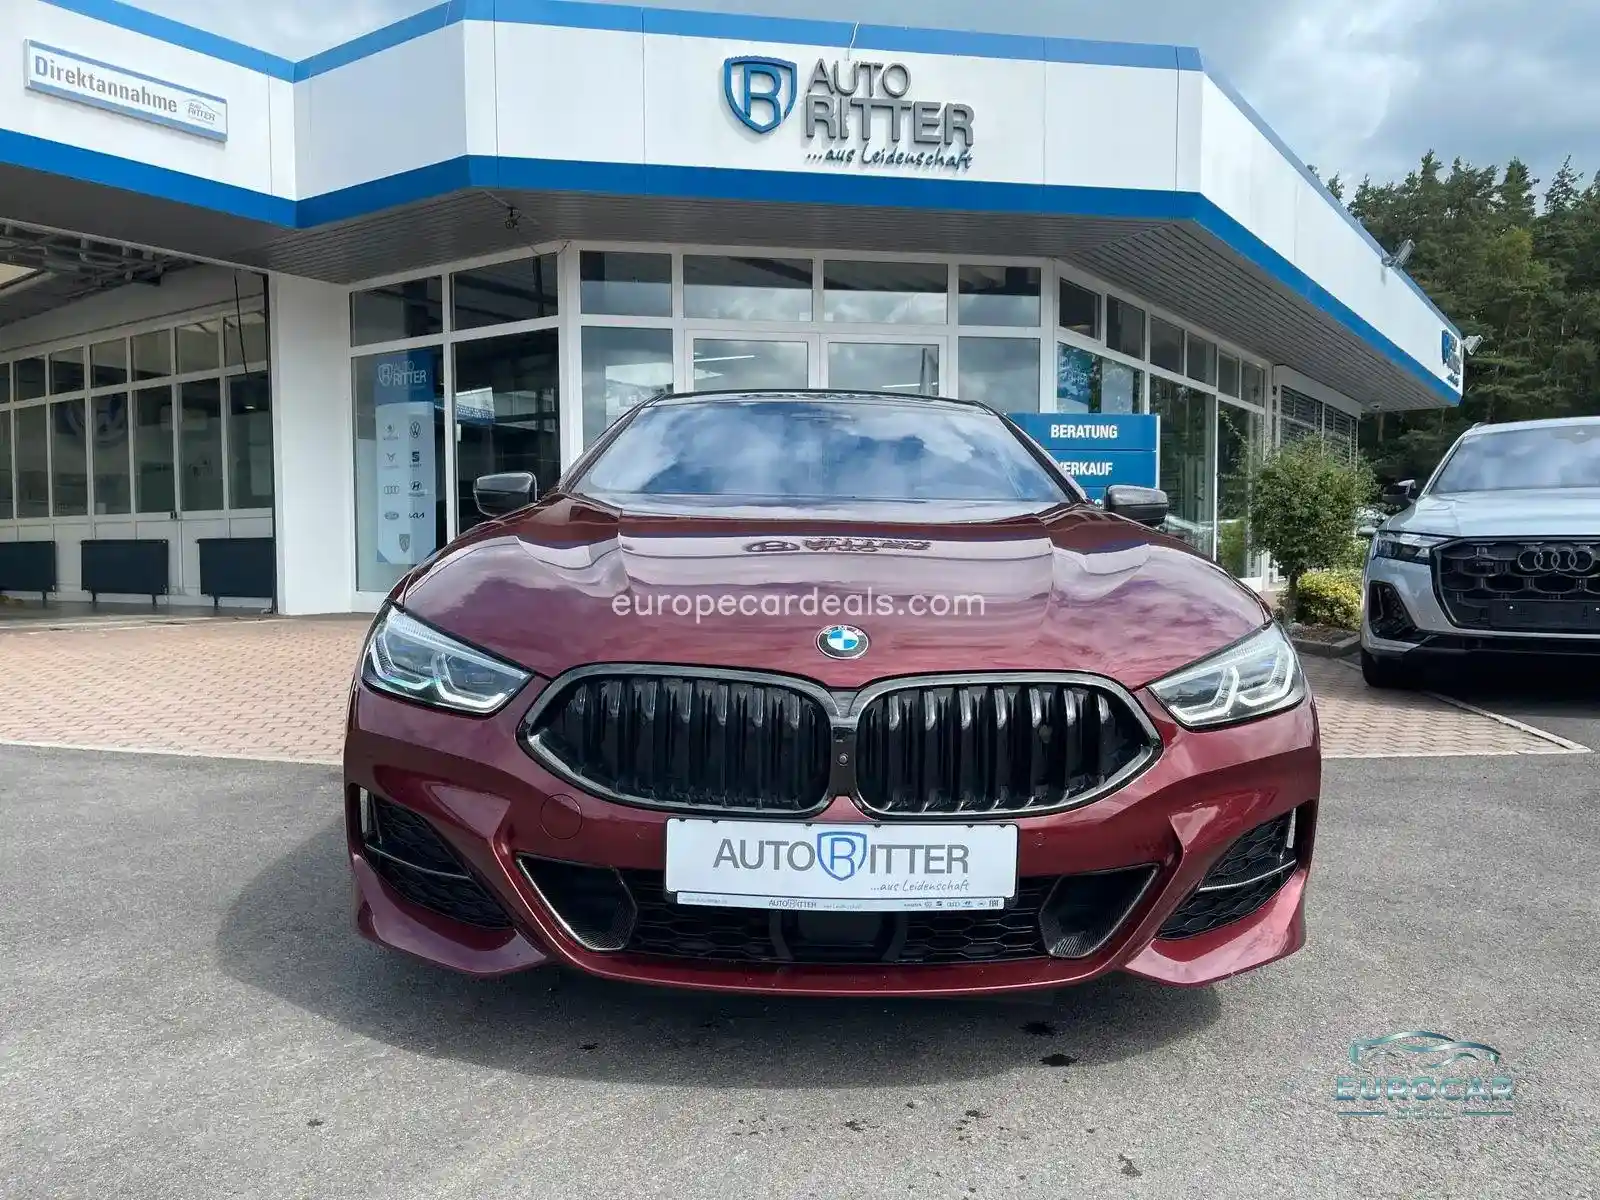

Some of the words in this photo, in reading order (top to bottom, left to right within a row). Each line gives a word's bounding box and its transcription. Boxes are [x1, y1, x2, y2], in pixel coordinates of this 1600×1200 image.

[34, 54, 178, 114] Direktannahme
[807, 58, 912, 98] AUTO
[804, 94, 975, 146] RITTER
[861, 143, 973, 170] Leidenschaft
[392, 369, 427, 386] RITTER
[1051, 424, 1118, 439] BERATUNG
[902, 879, 969, 892] Leidenschaft
